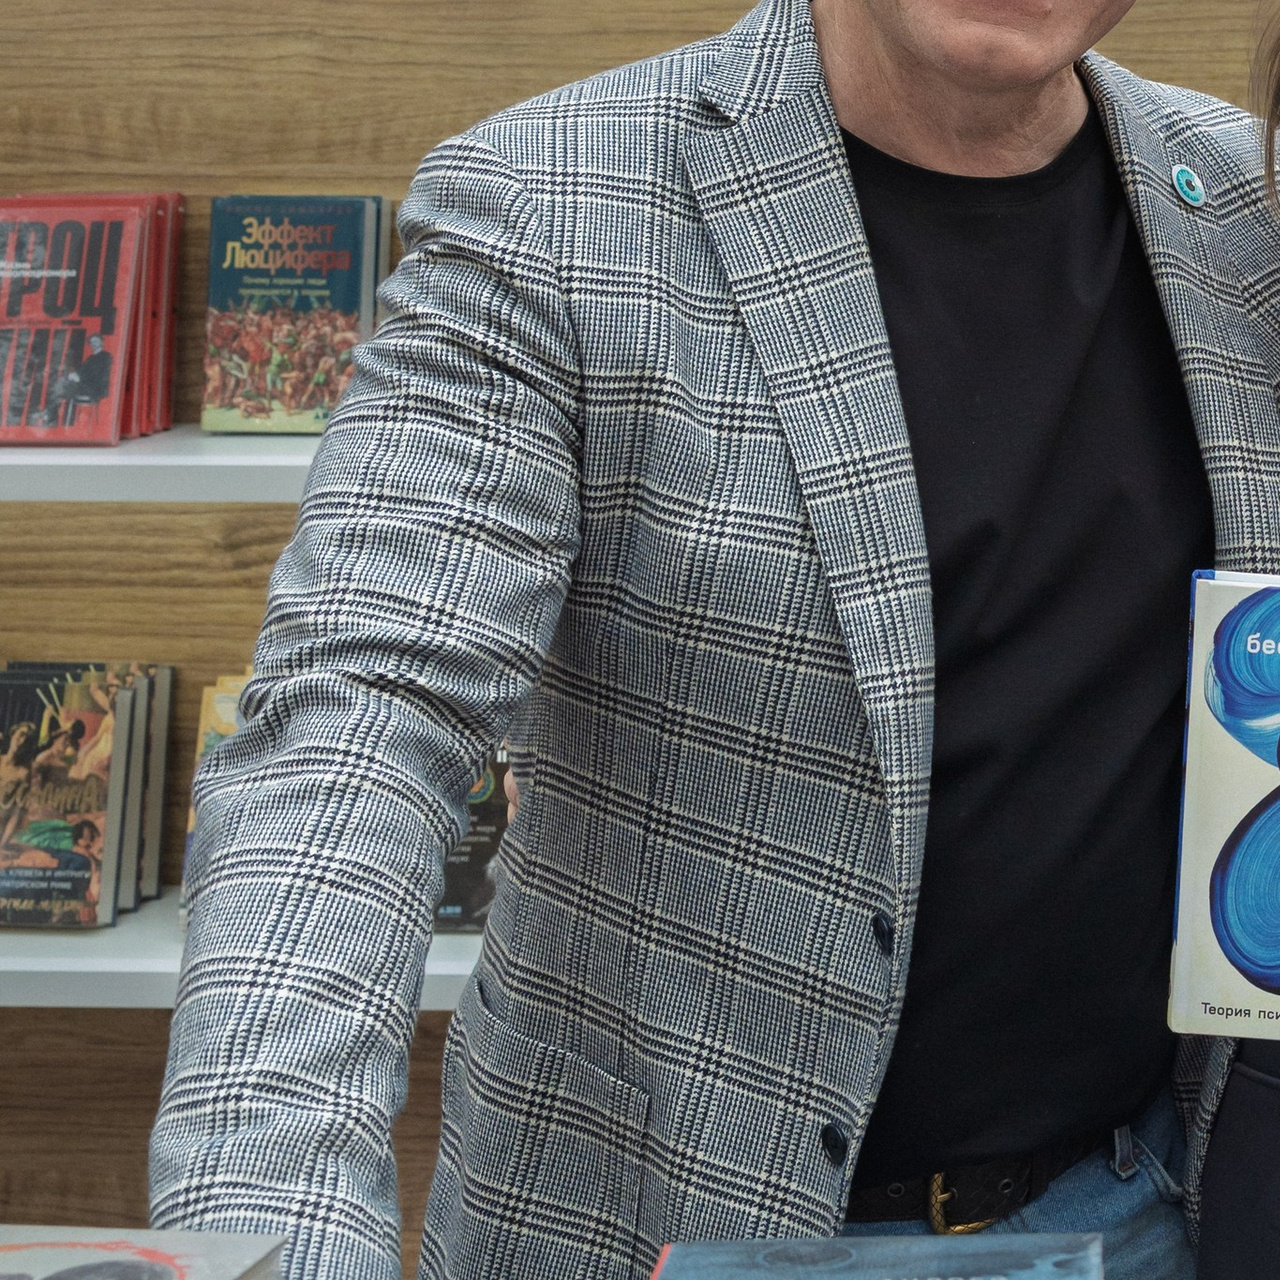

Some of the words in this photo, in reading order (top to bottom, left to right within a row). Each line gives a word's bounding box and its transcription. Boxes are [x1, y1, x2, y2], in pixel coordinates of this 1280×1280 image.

[242, 217, 336, 250] Эффект
[222, 241, 351, 276] Люцифера
[1201, 1002, 1251, 1021] Теория
